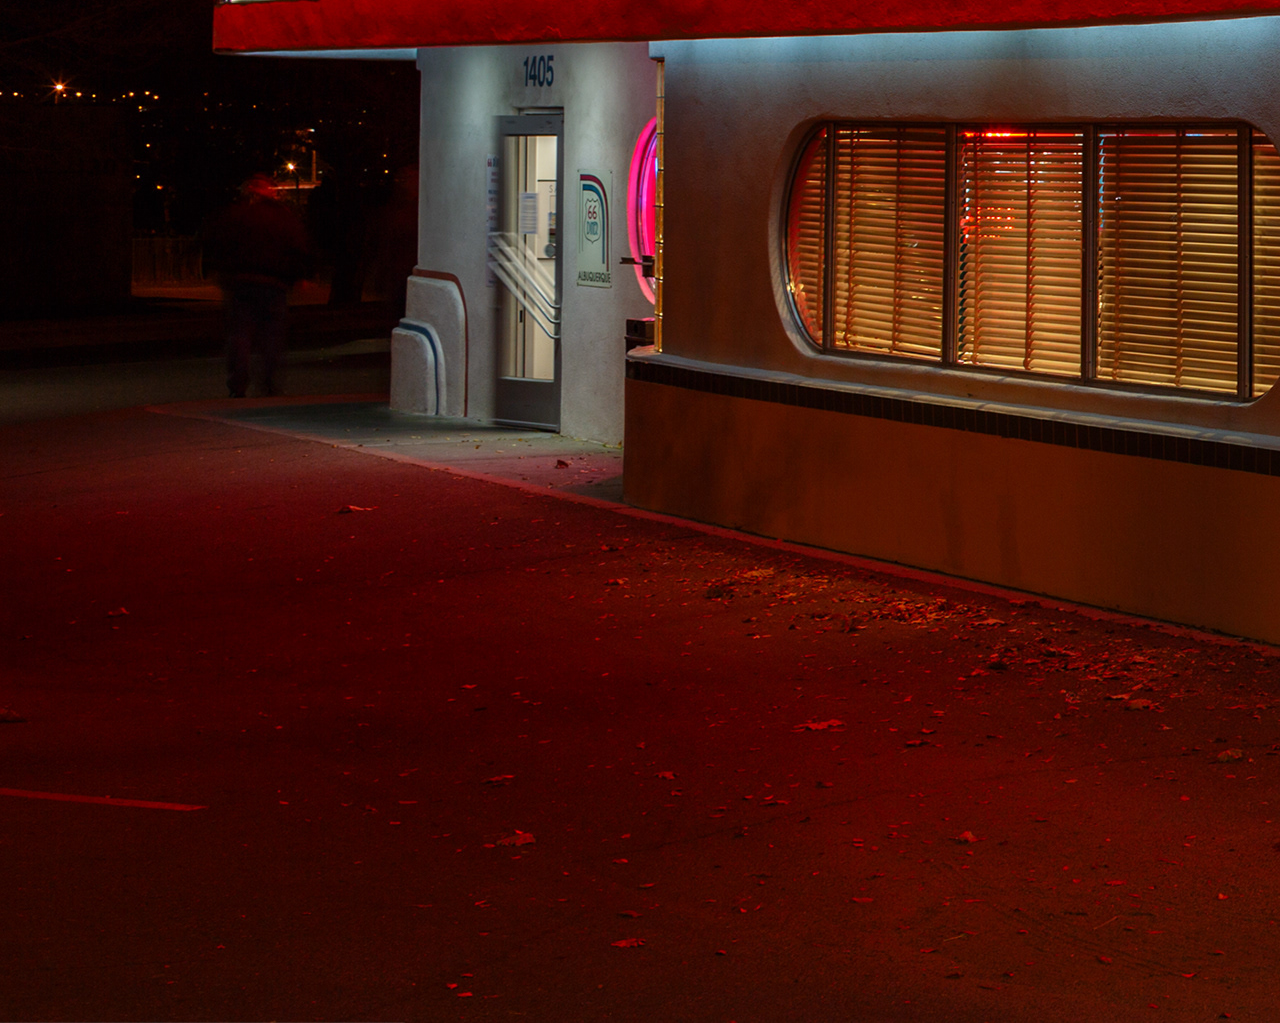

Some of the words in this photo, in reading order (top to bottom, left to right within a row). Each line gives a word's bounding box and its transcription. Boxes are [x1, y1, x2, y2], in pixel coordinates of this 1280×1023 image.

[523, 55, 554, 87] 1405
[587, 205, 598, 220] 66
[578, 271, 611, 283] ALBUQUERQUE
